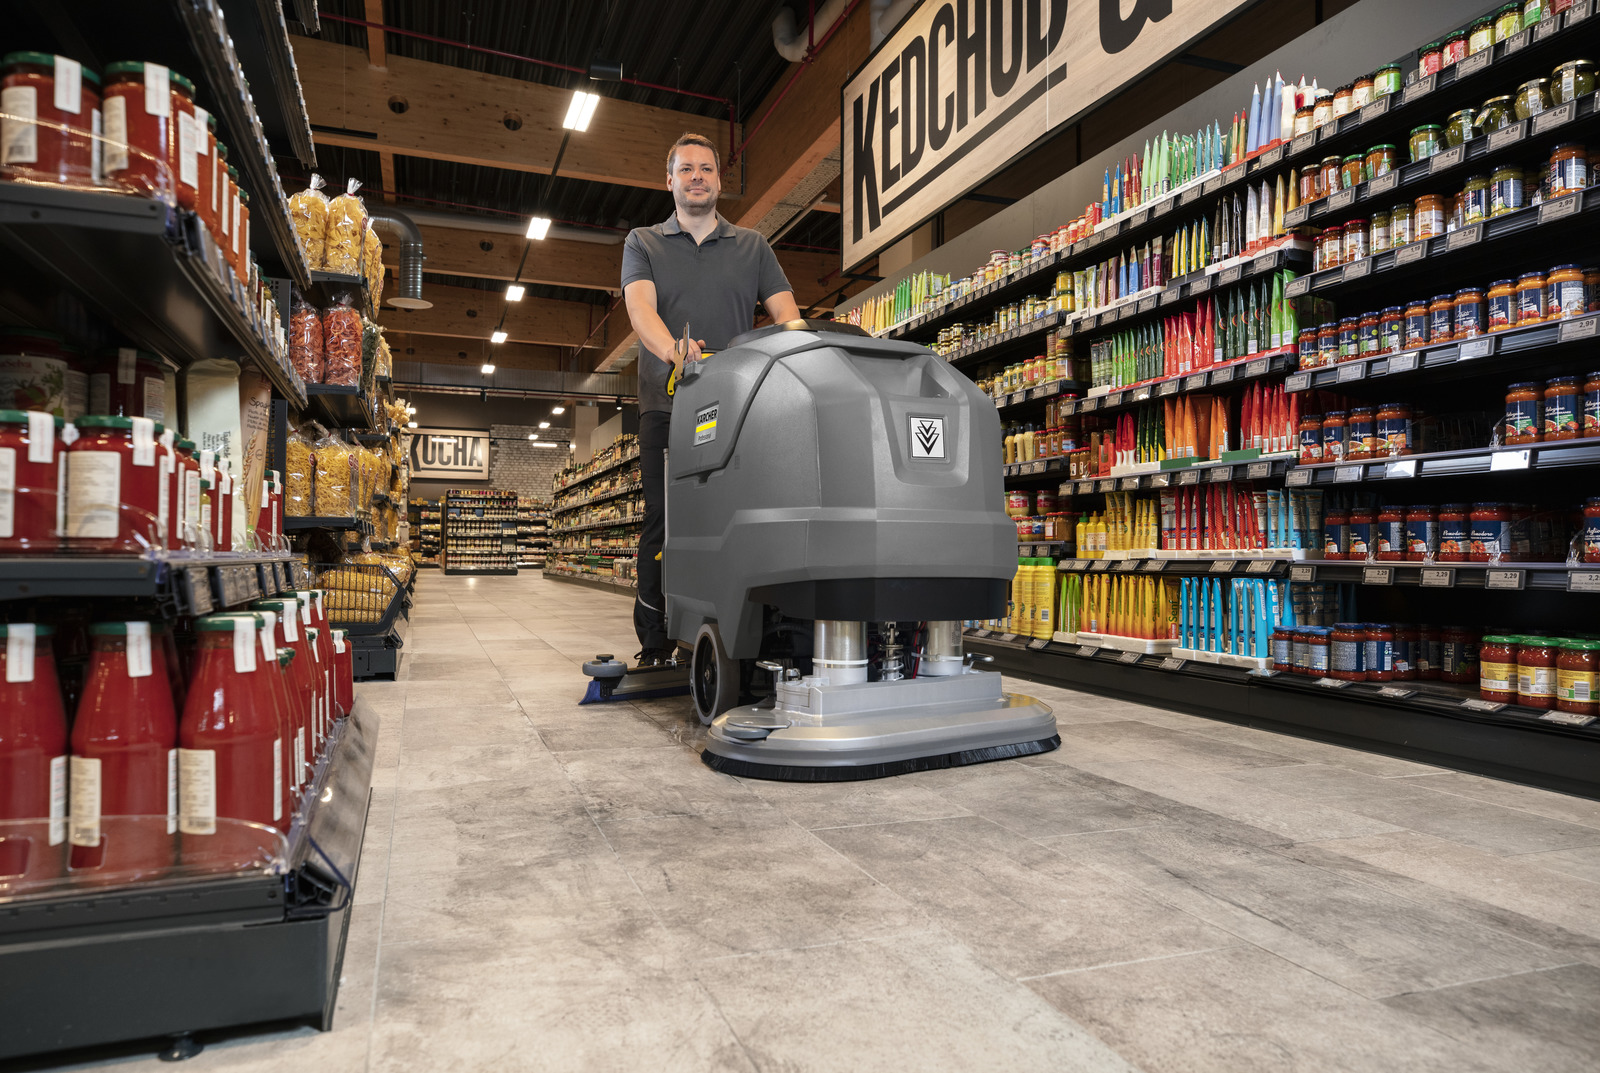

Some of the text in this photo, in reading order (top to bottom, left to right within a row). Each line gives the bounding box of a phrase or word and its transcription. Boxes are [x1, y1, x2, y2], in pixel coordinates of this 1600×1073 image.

[1473, 54, 1486, 63] 2,79
[1552, 107, 1568, 117] 4,49
[1505, 126, 1519, 135] 4,49
[1446, 150, 1458, 158] 4,49
[1558, 198, 1574, 208] 2,99
[1462, 228, 1475, 237] 2,99
[1579, 320, 1594, 328] 2,99
[1168, 600, 1179, 622] Senf
